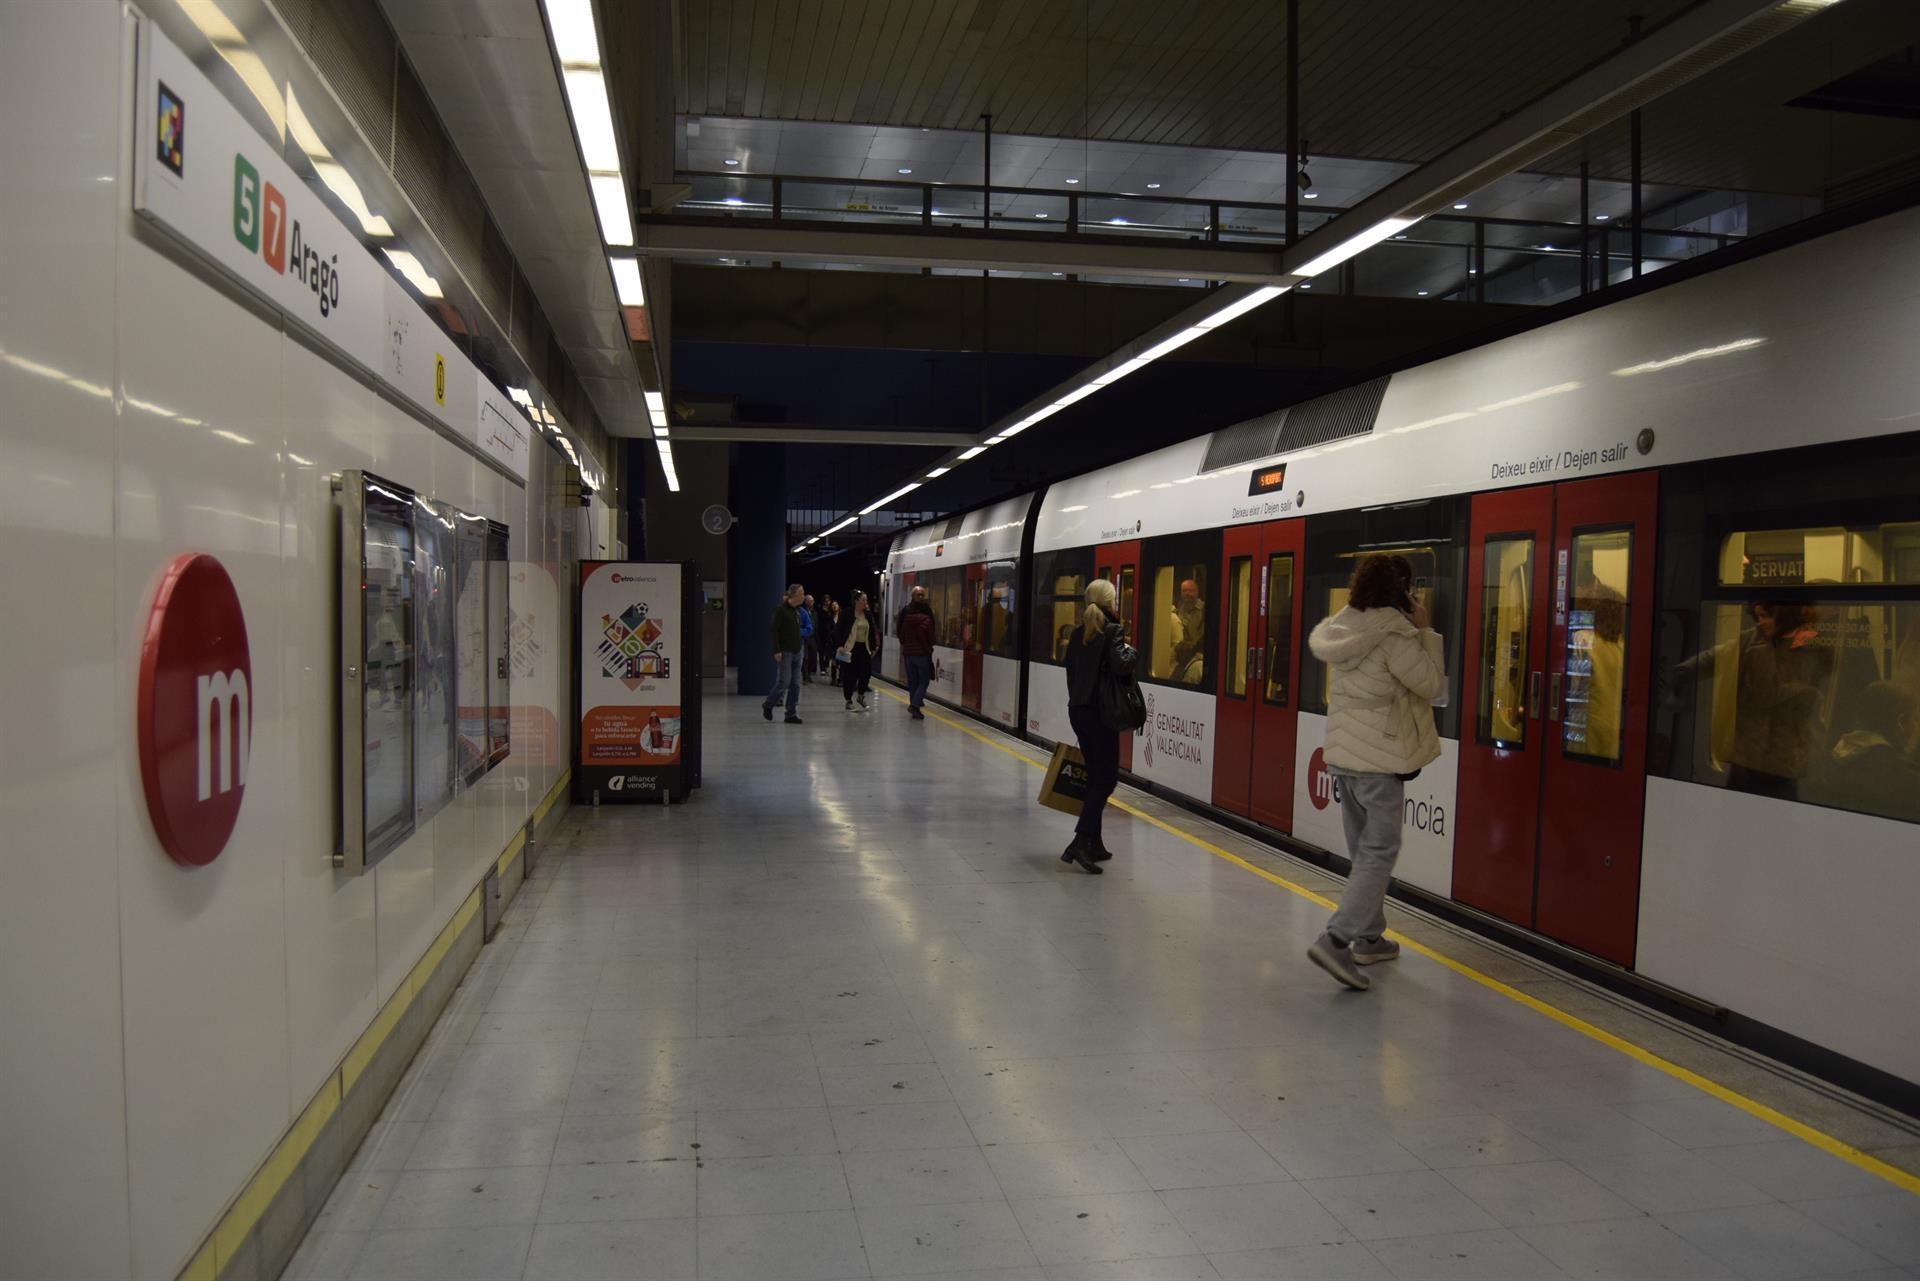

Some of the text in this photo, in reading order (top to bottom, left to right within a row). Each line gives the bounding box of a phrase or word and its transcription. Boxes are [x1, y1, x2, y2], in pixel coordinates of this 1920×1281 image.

[240, 173, 339, 318] 5 7 Aragó
[1491, 441, 1629, 480] Deixeu eixir / Dejen salir
[713, 515, 723, 530] 2
[1264, 502, 1280, 516] Dejen
[197, 667, 250, 803] m
[1156, 713, 1205, 741] GENERALITAT
[1156, 734, 1202, 765] VALENCIANA
[627, 775, 656, 783] alliance
